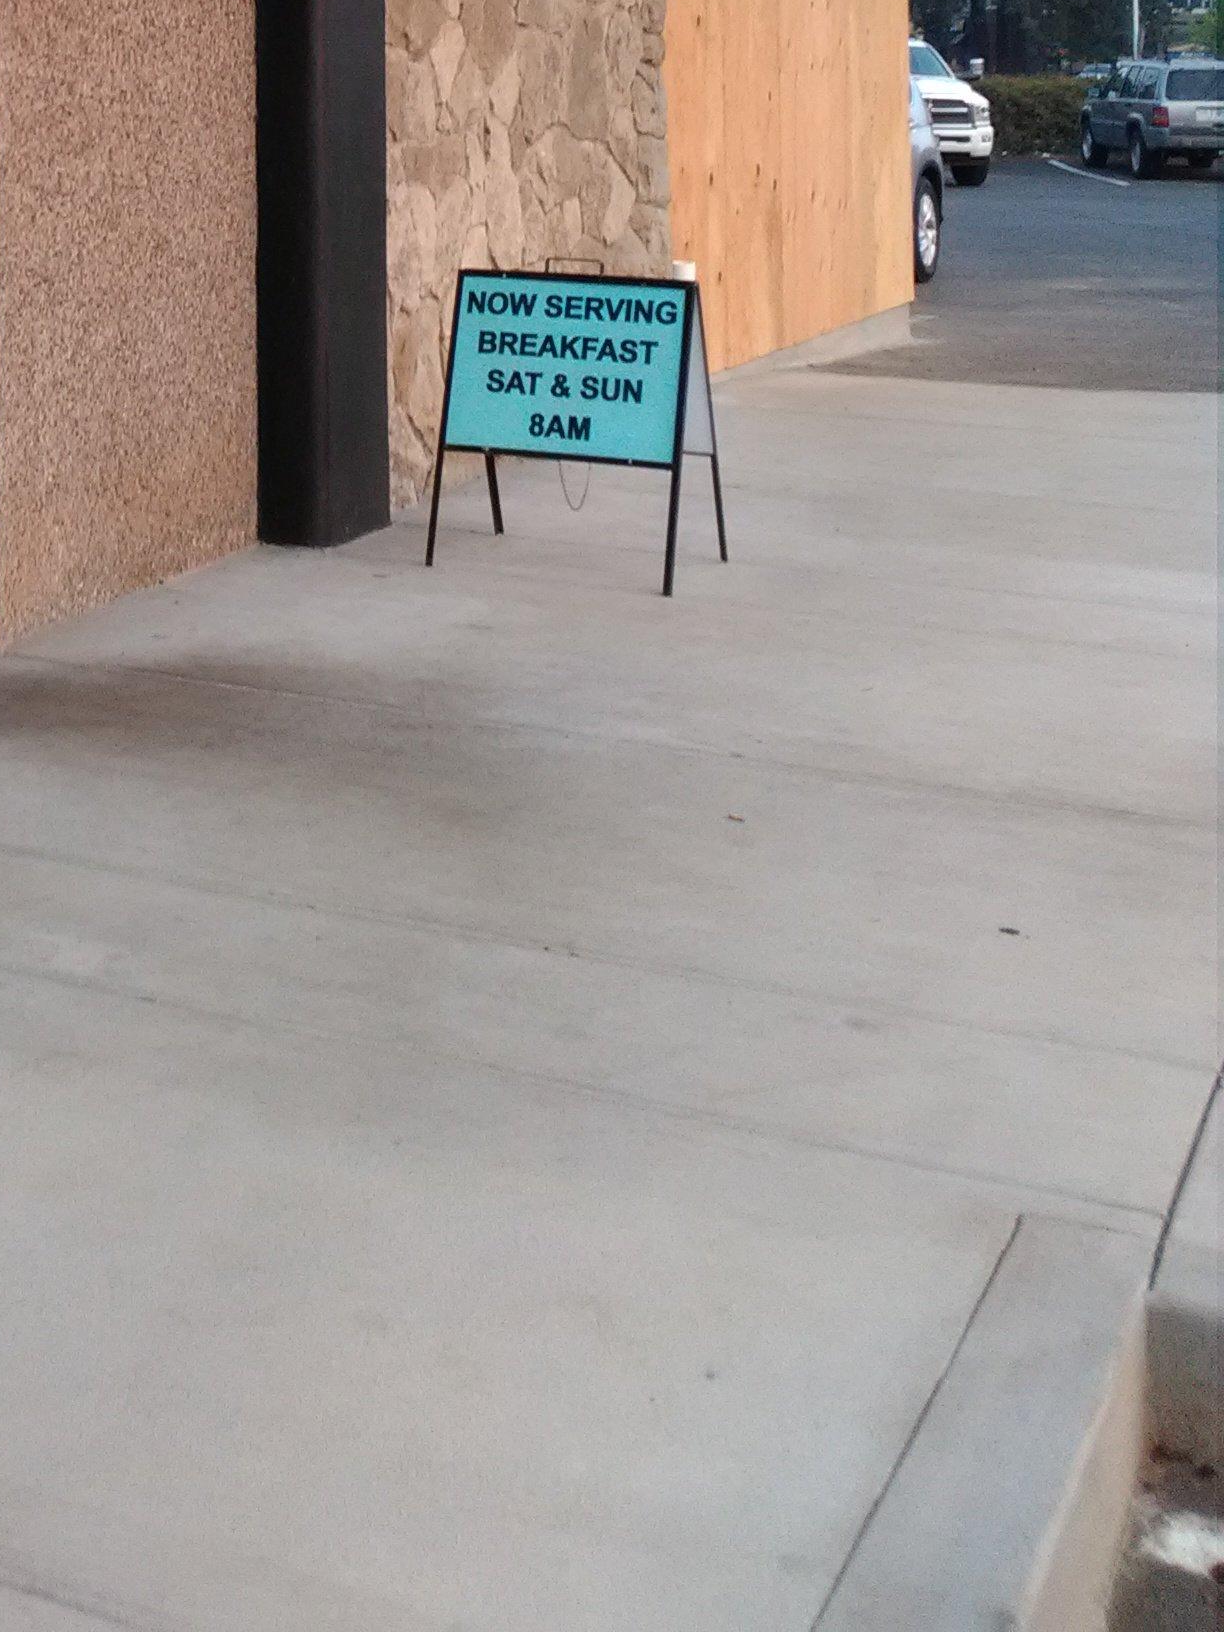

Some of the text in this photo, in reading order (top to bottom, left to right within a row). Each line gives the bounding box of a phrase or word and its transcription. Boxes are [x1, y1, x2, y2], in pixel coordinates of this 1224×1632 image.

[466, 290, 677, 325] NOW SERVING
[478, 329, 659, 364] BREAKFAST
[486, 369, 643, 404] SAT & SUN
[529, 413, 591, 441] 8AM
